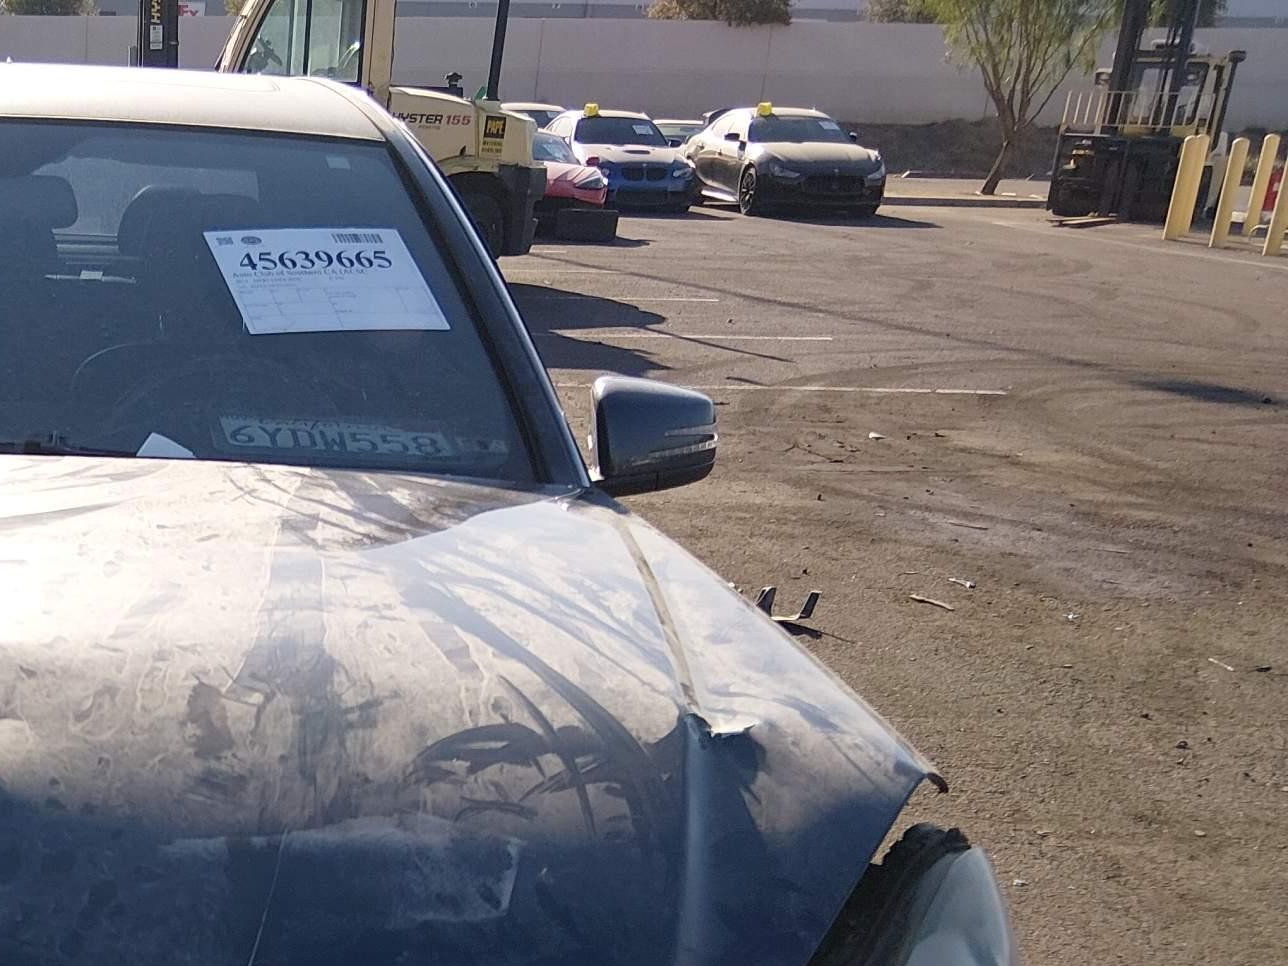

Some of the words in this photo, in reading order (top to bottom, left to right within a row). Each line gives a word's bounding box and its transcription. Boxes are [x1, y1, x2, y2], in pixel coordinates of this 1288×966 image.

[446, 115, 472, 125] 155
[239, 249, 393, 271] 45639665
[228, 424, 443, 455] 6YDW558
